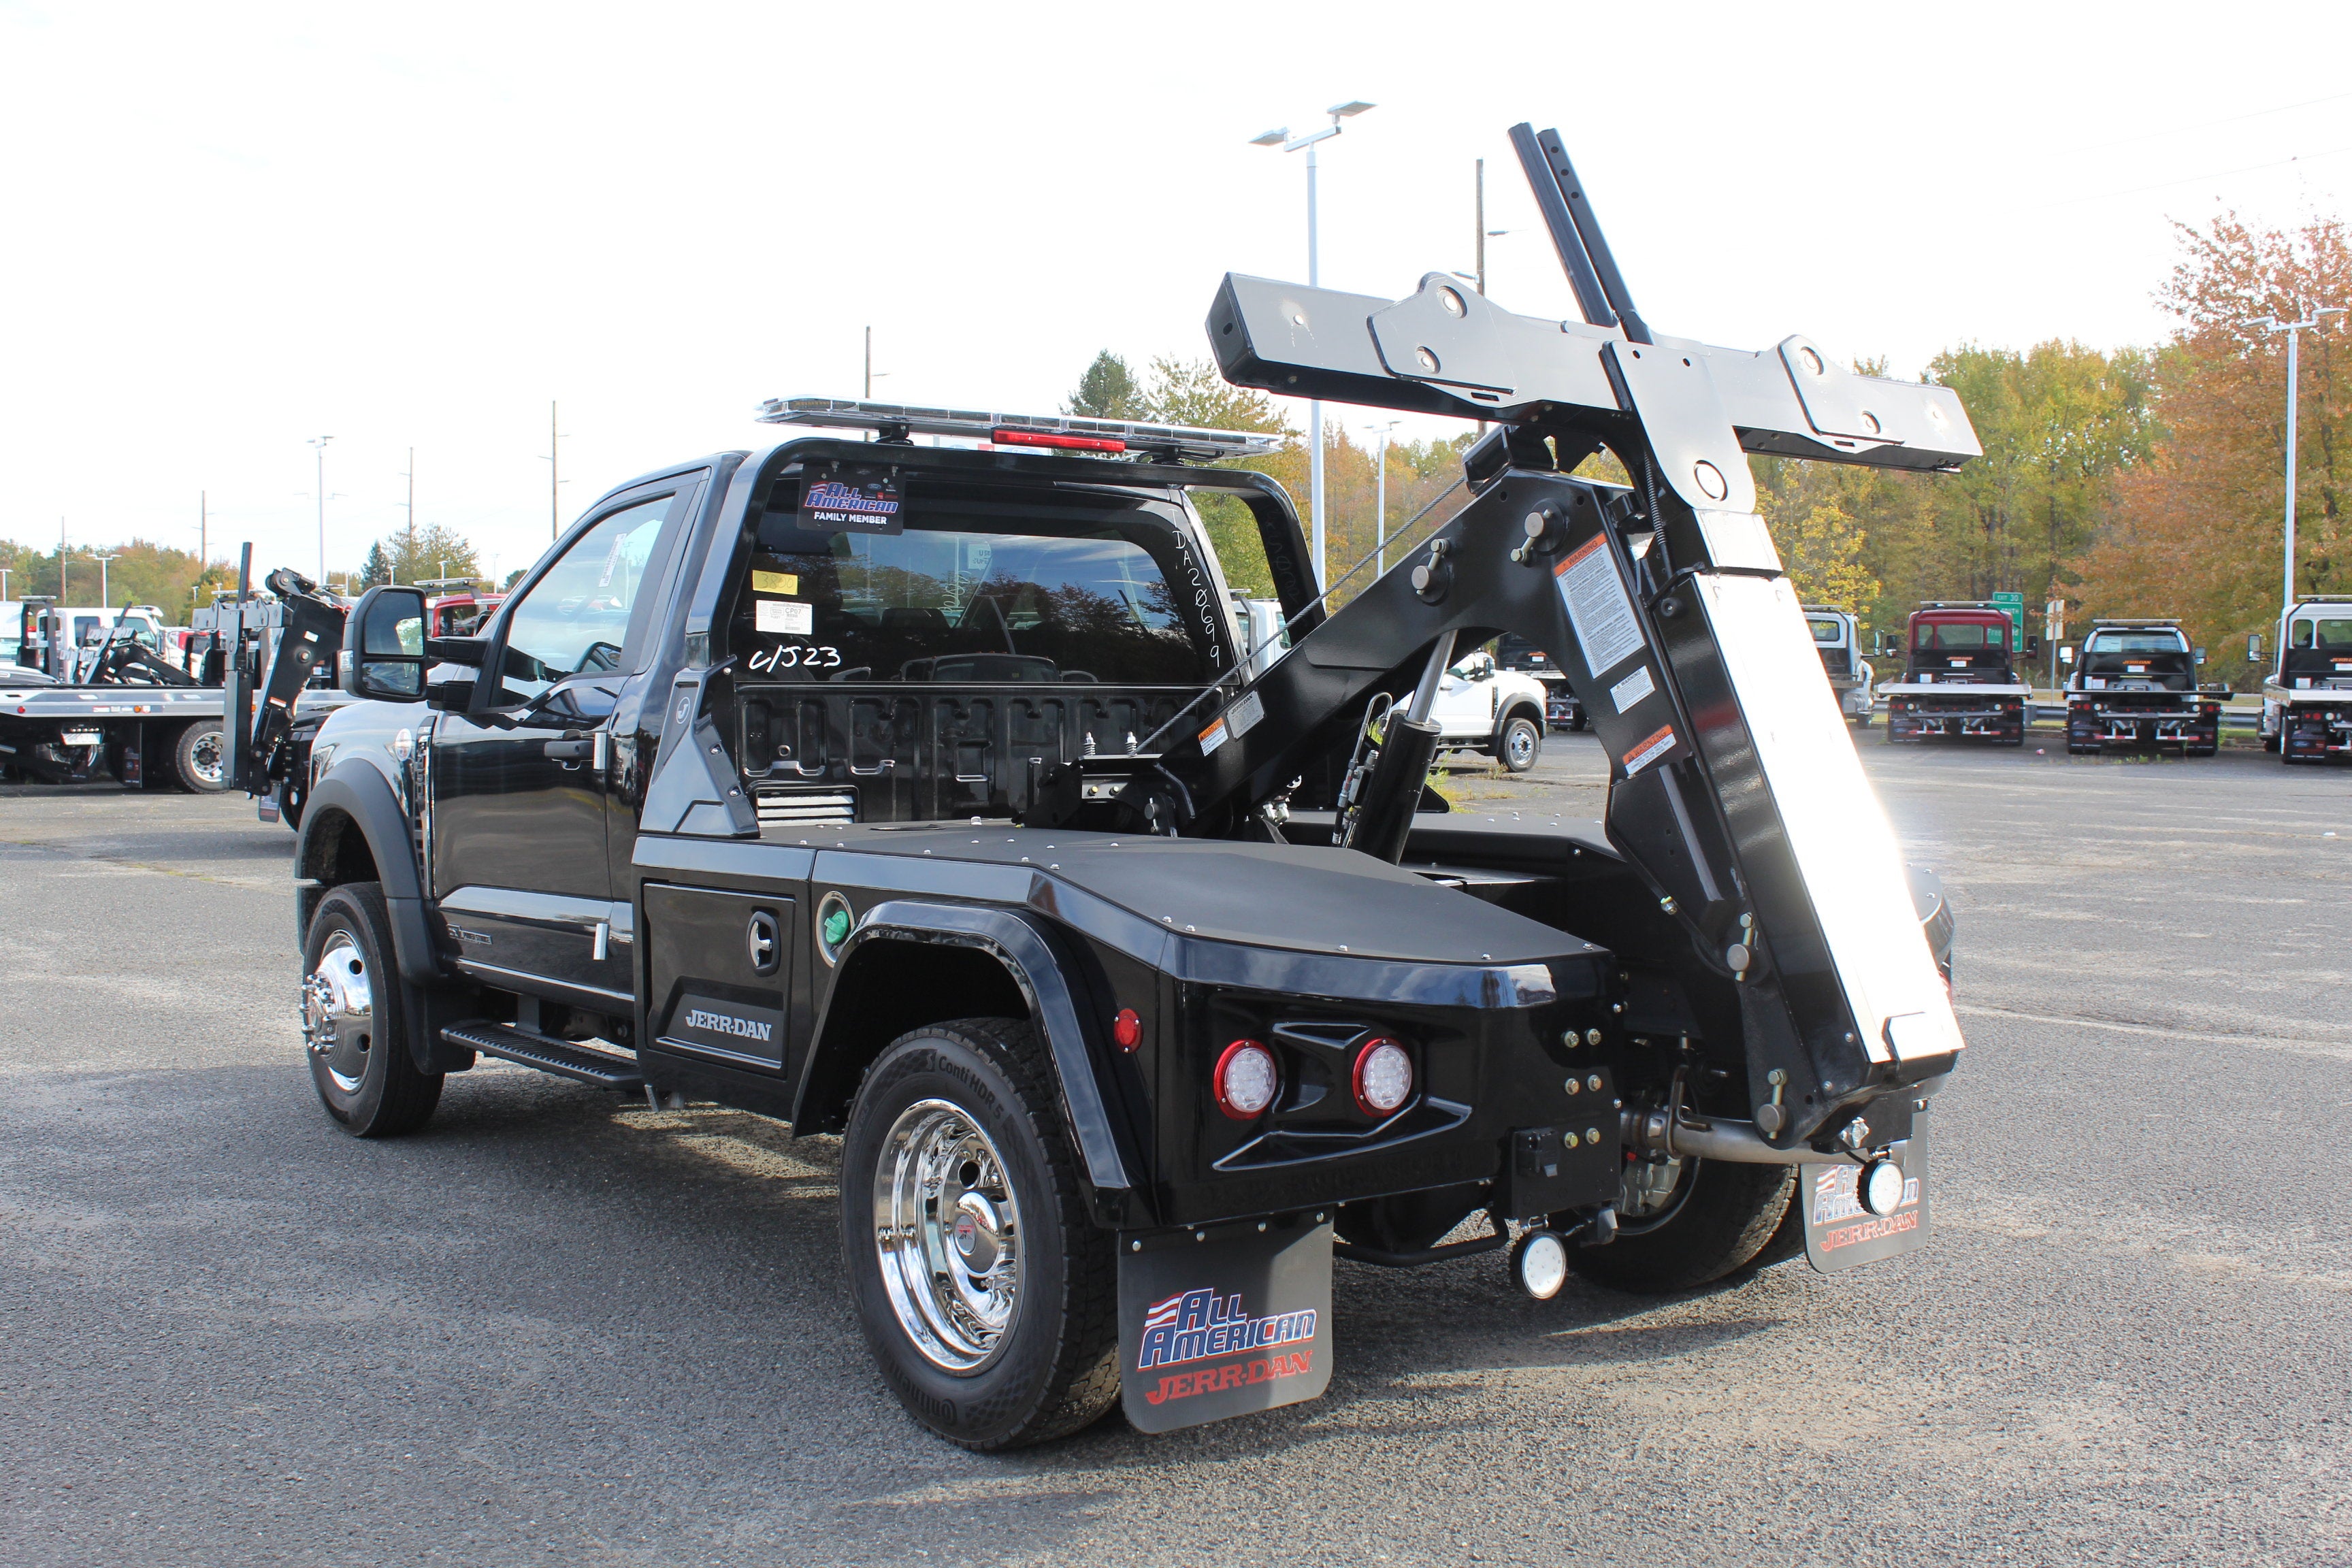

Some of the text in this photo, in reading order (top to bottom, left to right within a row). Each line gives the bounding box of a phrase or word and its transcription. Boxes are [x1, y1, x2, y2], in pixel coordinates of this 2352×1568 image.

[804, 491, 898, 513] AMERICAN
[825, 482, 862, 499] ALL
[814, 511, 887, 525] FAMILY MEMBER
[1567, 540, 1598, 566] WARNING
[759, 573, 794, 589] 3800
[1620, 670, 1642, 686] WARNING
[1633, 729, 1667, 756] WARNING
[685, 1009, 772, 1041] JERR-DAN
[939, 1056, 1005, 1120] Conti HDR 5
[1818, 1209, 1918, 1252] JERR-DAN
[1176, 1287, 1248, 1332] ALL
[1138, 1308, 1318, 1370] AMERICAN
[1145, 1350, 1313, 1406] JERR-DAN
